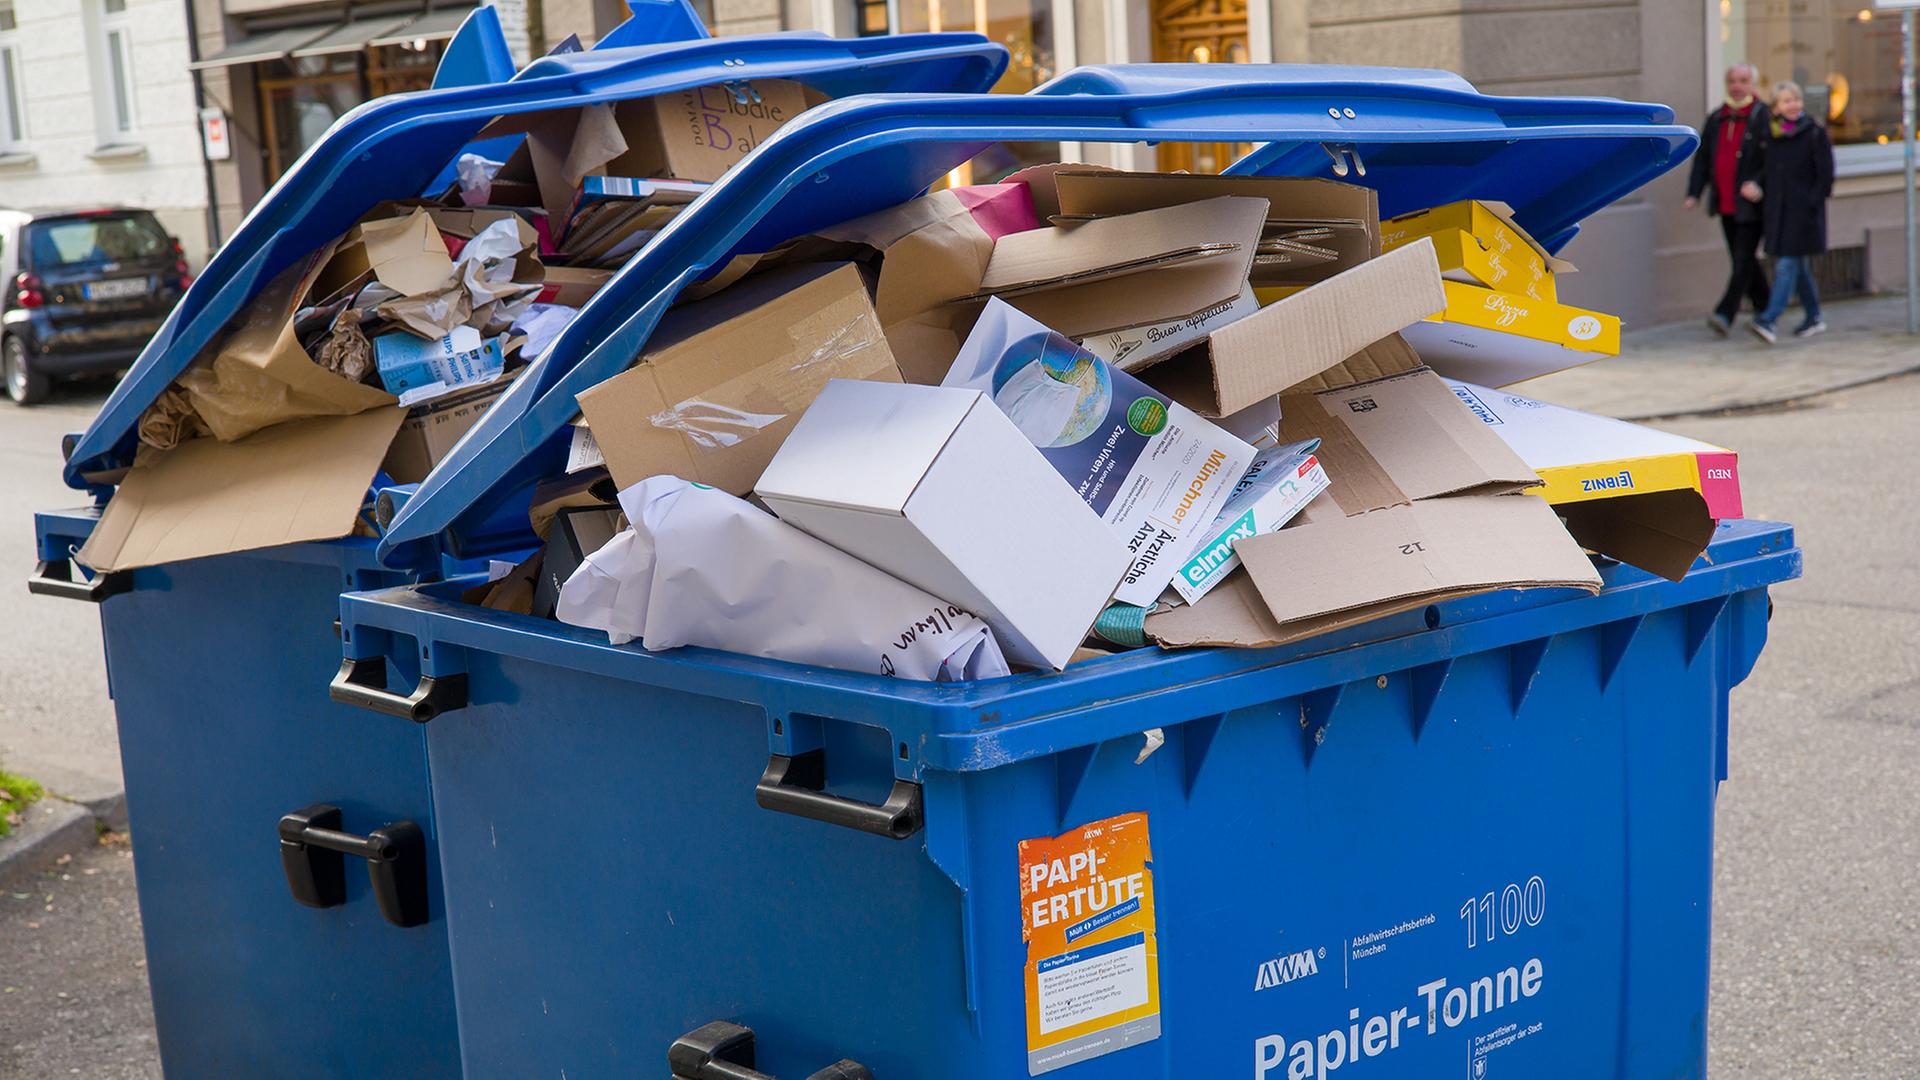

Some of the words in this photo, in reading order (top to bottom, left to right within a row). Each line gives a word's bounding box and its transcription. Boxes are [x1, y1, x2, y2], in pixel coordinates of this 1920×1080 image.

[703, 113, 762, 154] Bal
[1484, 294, 1528, 328] Pizza
[1146, 323, 1184, 344] Buon
[1575, 321, 1593, 335] 33
[1106, 425, 1126, 449] Zwei
[1091, 448, 1112, 473] Viren
[1106, 459, 1116, 472] HIV
[1707, 468, 1732, 480] NEU
[1079, 480, 1091, 497] zw
[1099, 470, 1109, 483] und
[1171, 449, 1228, 525] Münchner
[1581, 470, 1634, 491] LEIBNIZ
[1124, 529, 1177, 585] Ärztliche
[1398, 541, 1425, 555] 12
[1029, 848, 1106, 894] PAPI-
[1031, 871, 1145, 929] ERTÜTE
[1460, 875, 1546, 949] 1100
[1068, 925, 1083, 938] Müll
[1091, 913, 1113, 927] Besser
[1112, 900, 1138, 918] trennen!
[1351, 913, 1436, 949] Abfallwirtschaftsbetrieb
[1351, 942, 1387, 961] München
[1254, 948, 1319, 992] AWM
[1255, 957, 1544, 1080] Papier-Tonne
[1474, 1036, 1486, 1047] Der
[1486, 1023, 1518, 1041] zertifizierte
[1474, 1034, 1517, 1057] Abfallentsorger
[1516, 1029, 1527, 1040] der
[1527, 1022, 1543, 1035] Stadt
